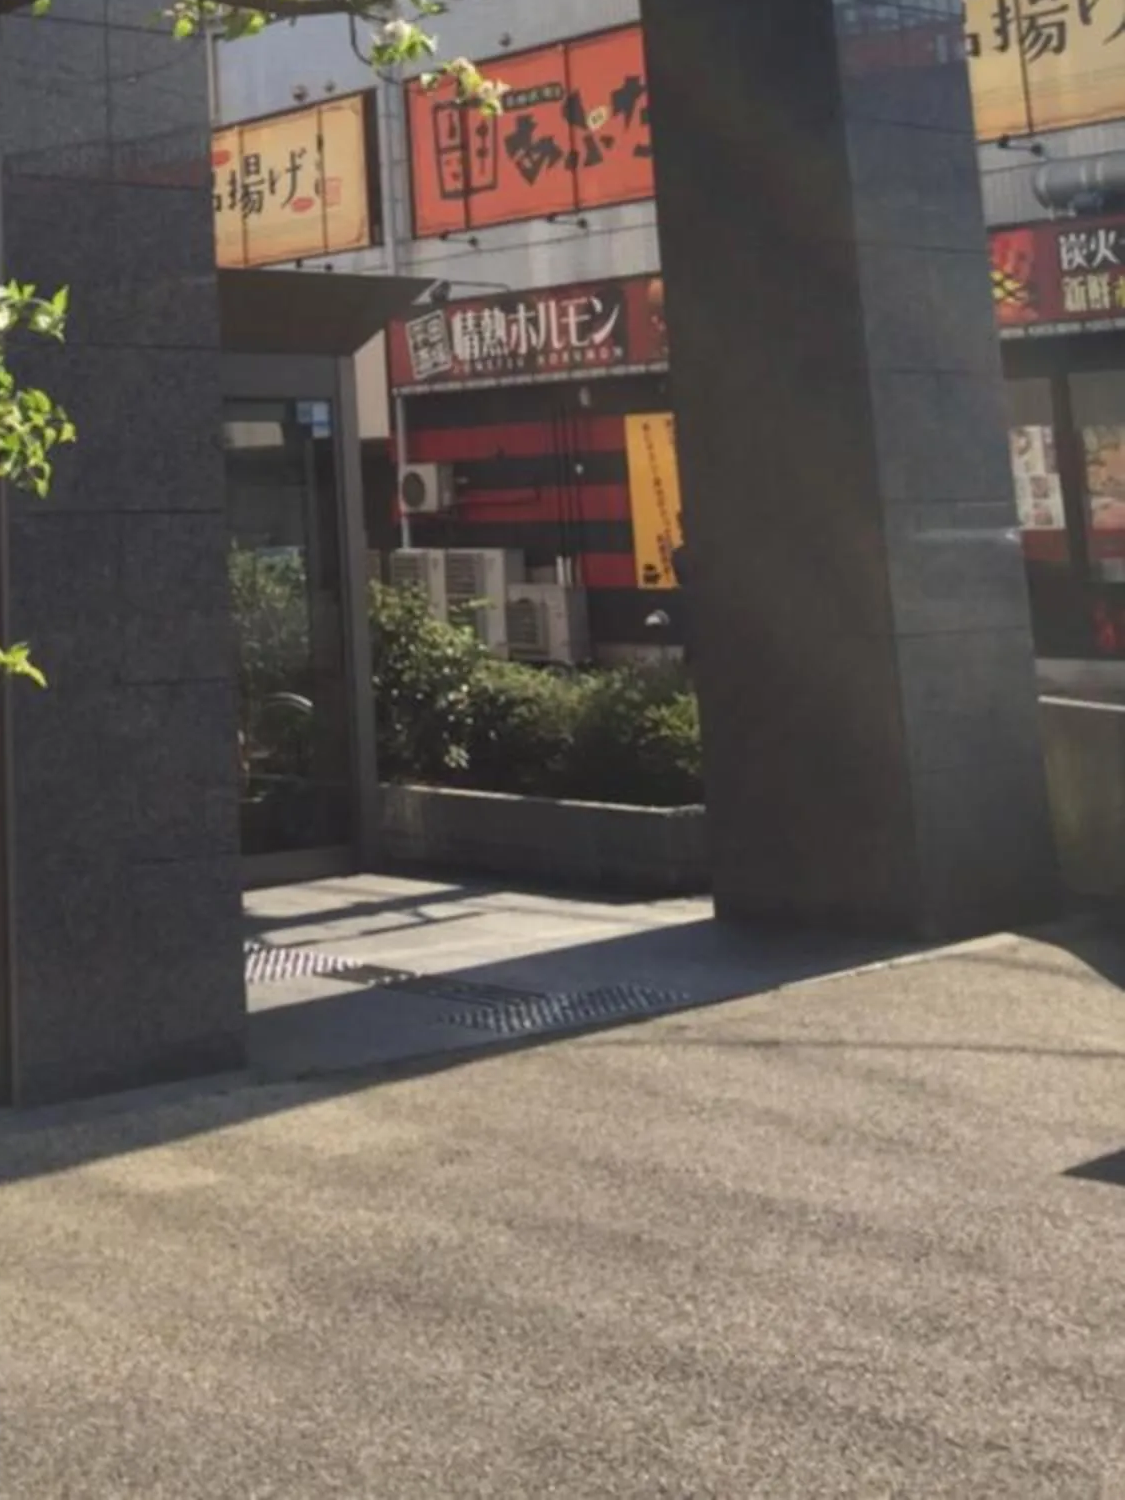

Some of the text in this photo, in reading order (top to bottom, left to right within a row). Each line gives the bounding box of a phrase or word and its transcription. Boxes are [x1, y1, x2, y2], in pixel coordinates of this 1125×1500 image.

[1058, 229, 1125, 270] 炭火
[451, 295, 620, 361] 情熱ホルモン
